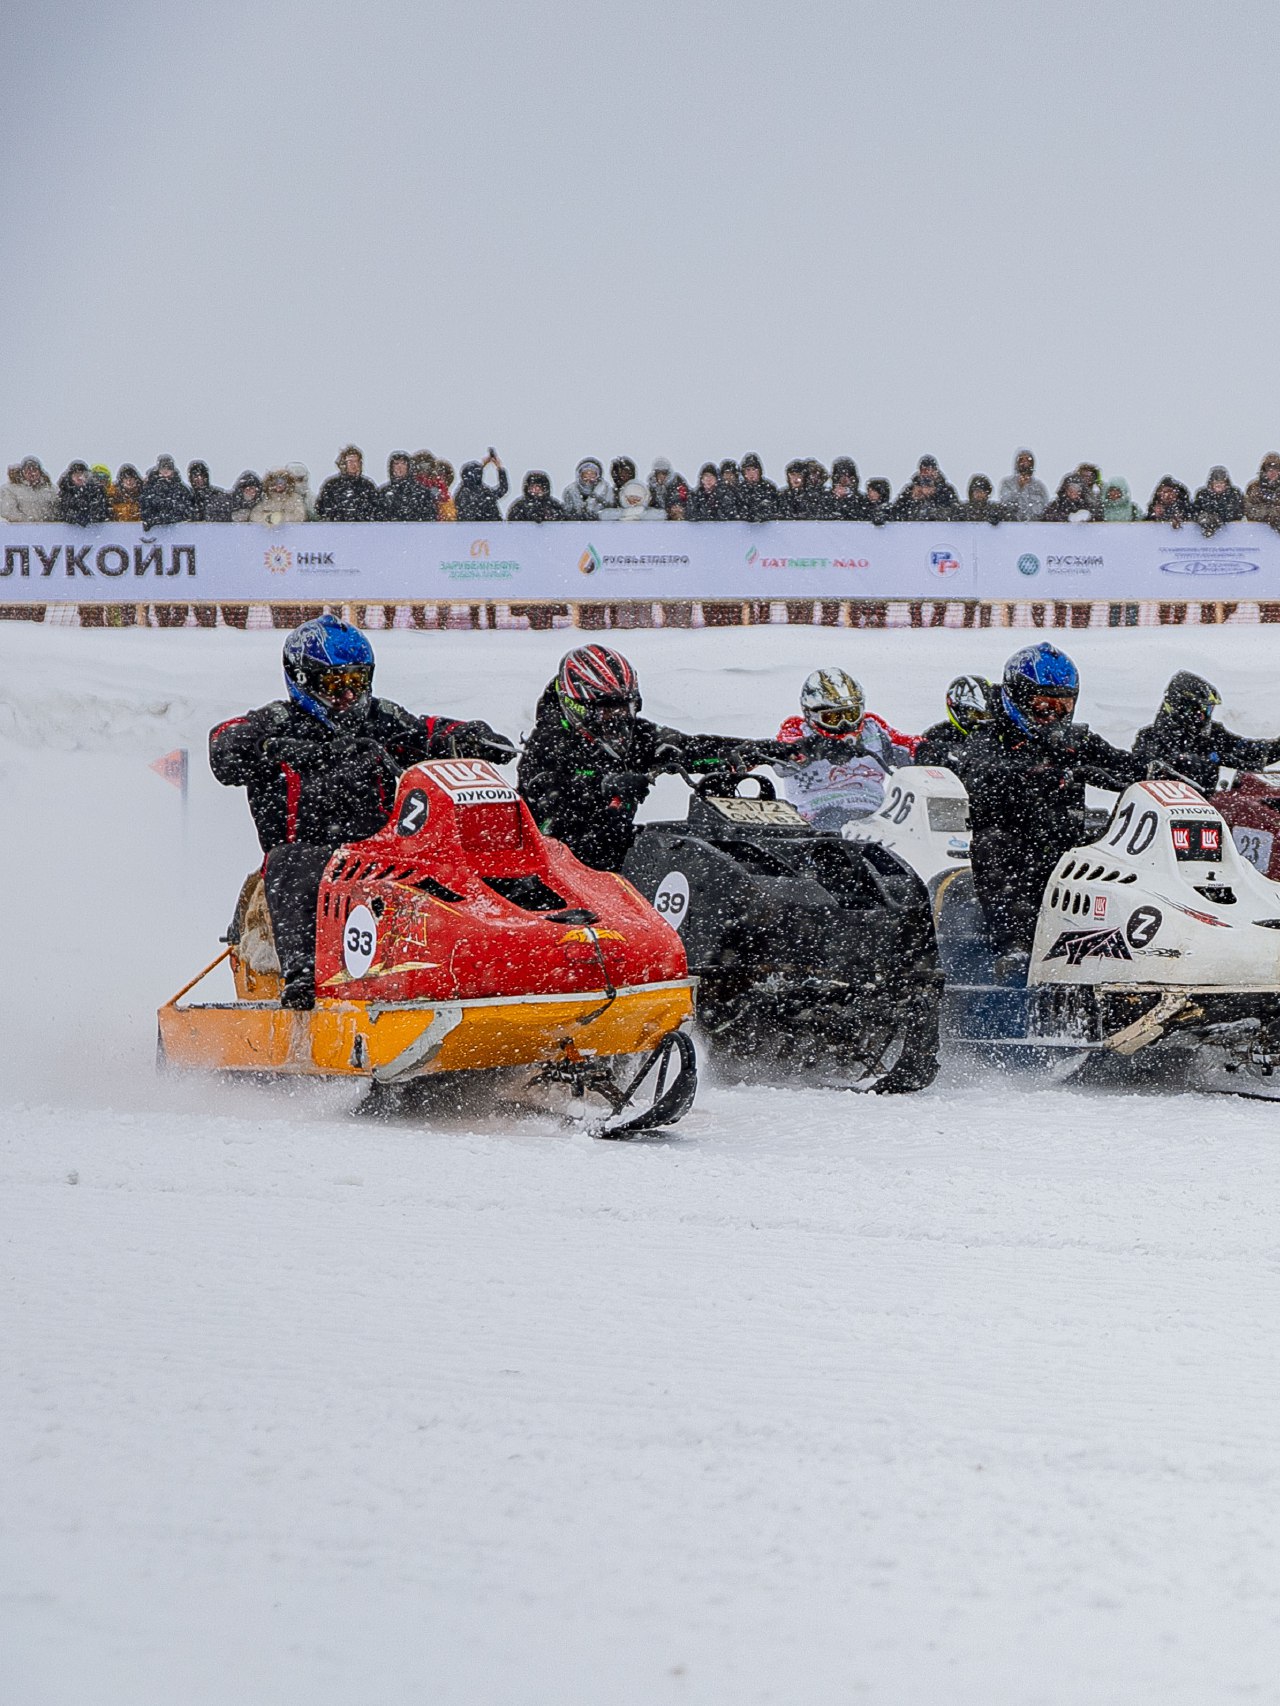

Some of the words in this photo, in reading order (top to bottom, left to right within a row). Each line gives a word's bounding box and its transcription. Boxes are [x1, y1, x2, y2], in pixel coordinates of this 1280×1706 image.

[0, 536, 196, 577] ЛУКОЙЛ
[297, 552, 334, 565] ННК
[879, 786, 915, 825] 26
[1108, 802, 1159, 855] 10
[1240, 834, 1261, 865] 23
[657, 892, 685, 914] 39
[347, 927, 373, 956] 33
